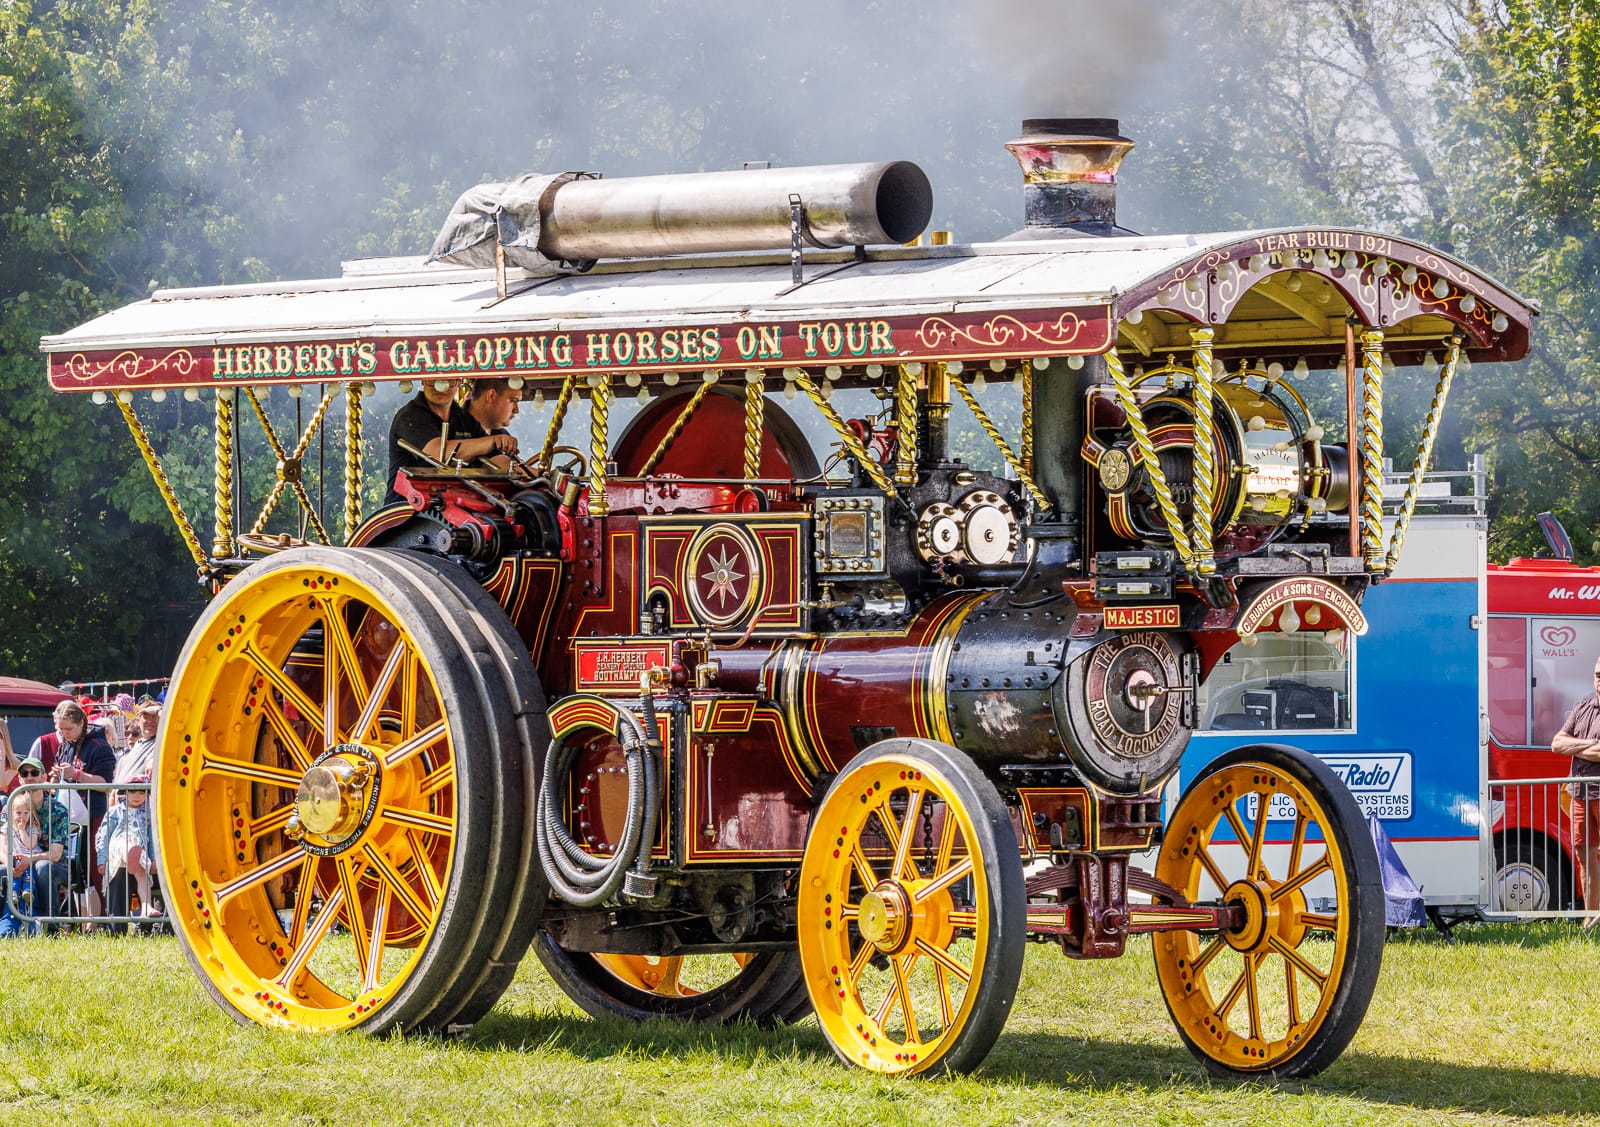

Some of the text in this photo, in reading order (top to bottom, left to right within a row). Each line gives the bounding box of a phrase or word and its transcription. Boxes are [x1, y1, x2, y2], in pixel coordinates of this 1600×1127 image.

[1255, 231, 1393, 256] YEAR BUILT 1921
[212, 320, 896, 378] HERBERT'S GALLOPING HORSES ON TOUR
[1548, 587, 1575, 600] Mr.
[1107, 609, 1177, 626] MAJESTIC
[1249, 590, 1283, 624] BURRELL
[1283, 586, 1289, 597] &
[1290, 583, 1312, 595] SONS
[1325, 588, 1363, 630] ENGINEERS
[1094, 641, 1118, 670] THE
[1542, 648, 1576, 657] WALL'S
[1090, 698, 1181, 755] ROAD LOCOMOTIVE
[1346, 763, 1390, 786] Radio
[1250, 794, 1409, 806] PLIC SYSTEMS
[1366, 806, 1409, 816] 210285
